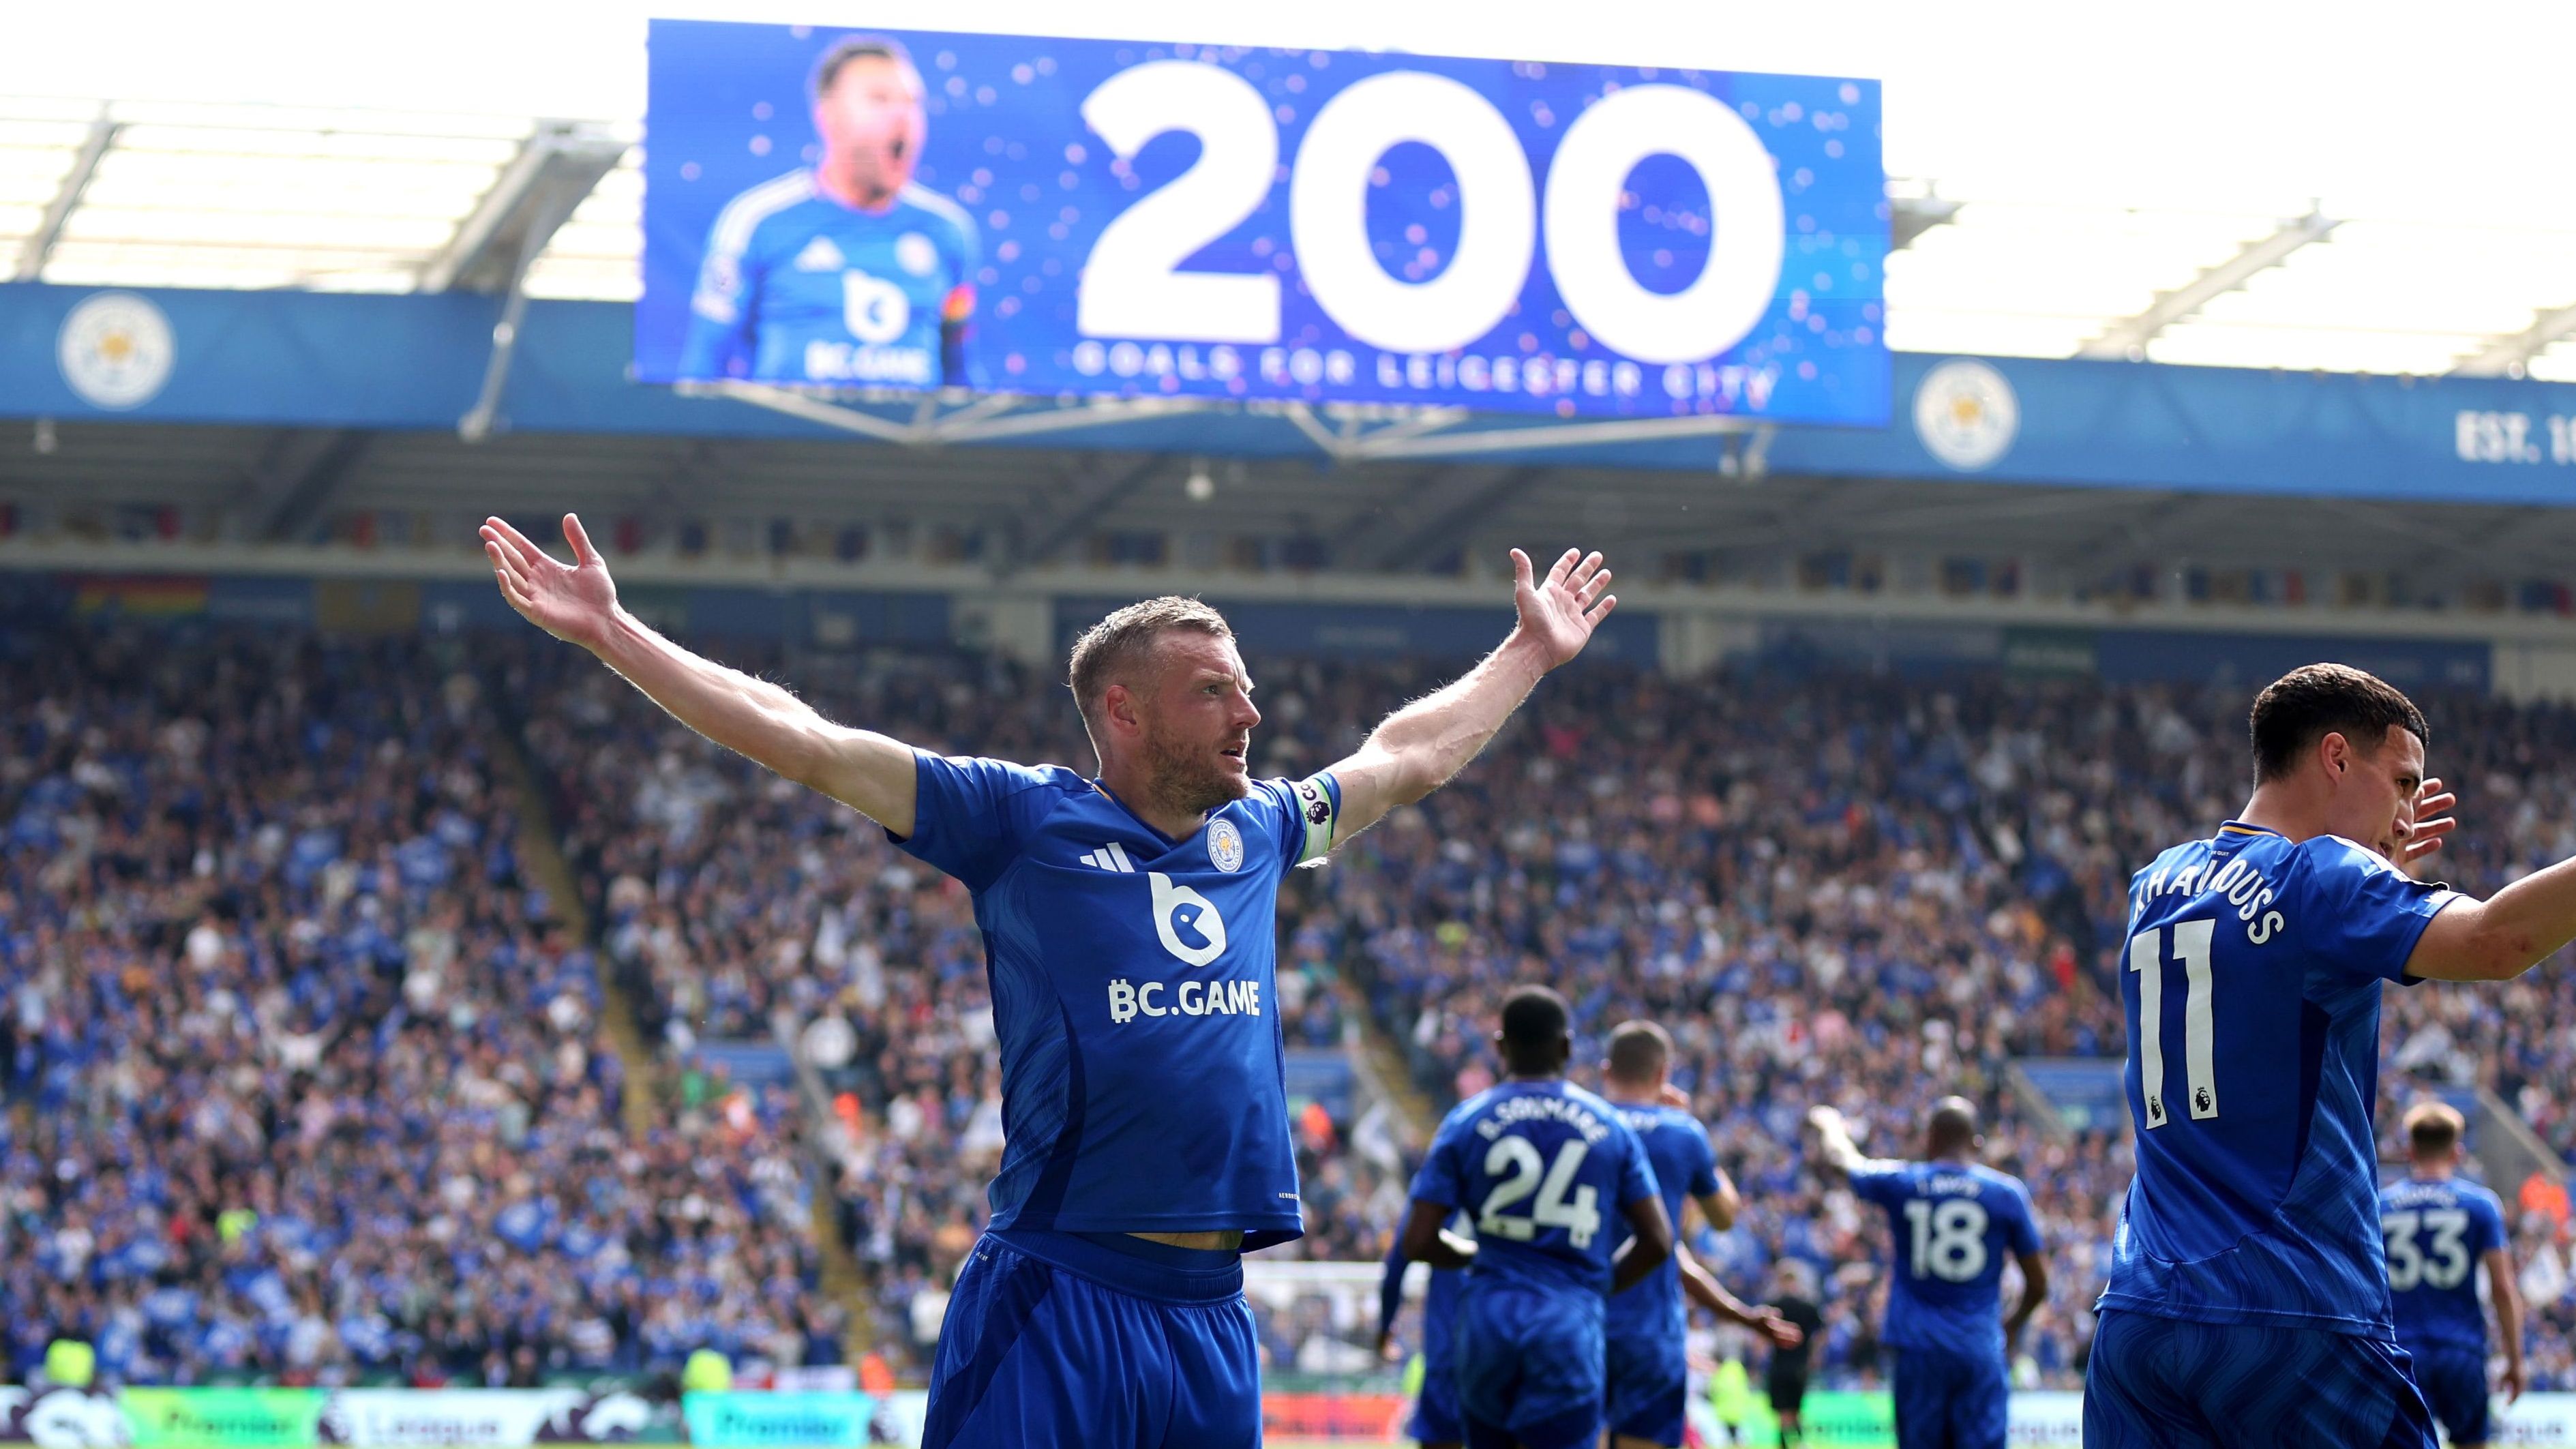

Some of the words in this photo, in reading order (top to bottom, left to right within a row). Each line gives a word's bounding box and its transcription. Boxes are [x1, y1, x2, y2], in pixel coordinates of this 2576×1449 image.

[1077, 58, 1785, 365] 200
[1073, 340, 1244, 383] GOALS
[1260, 346, 1357, 387] FOR
[1377, 352, 1642, 397] LEICESTER
[1662, 361, 1779, 410] CITY
[2456, 410, 2541, 466] EST.
[2129, 918, 2219, 1130] 11
[1478, 1135, 1601, 1249] 24
[1903, 1198, 1989, 1283] 18
[2381, 1207, 2470, 1291] 33
